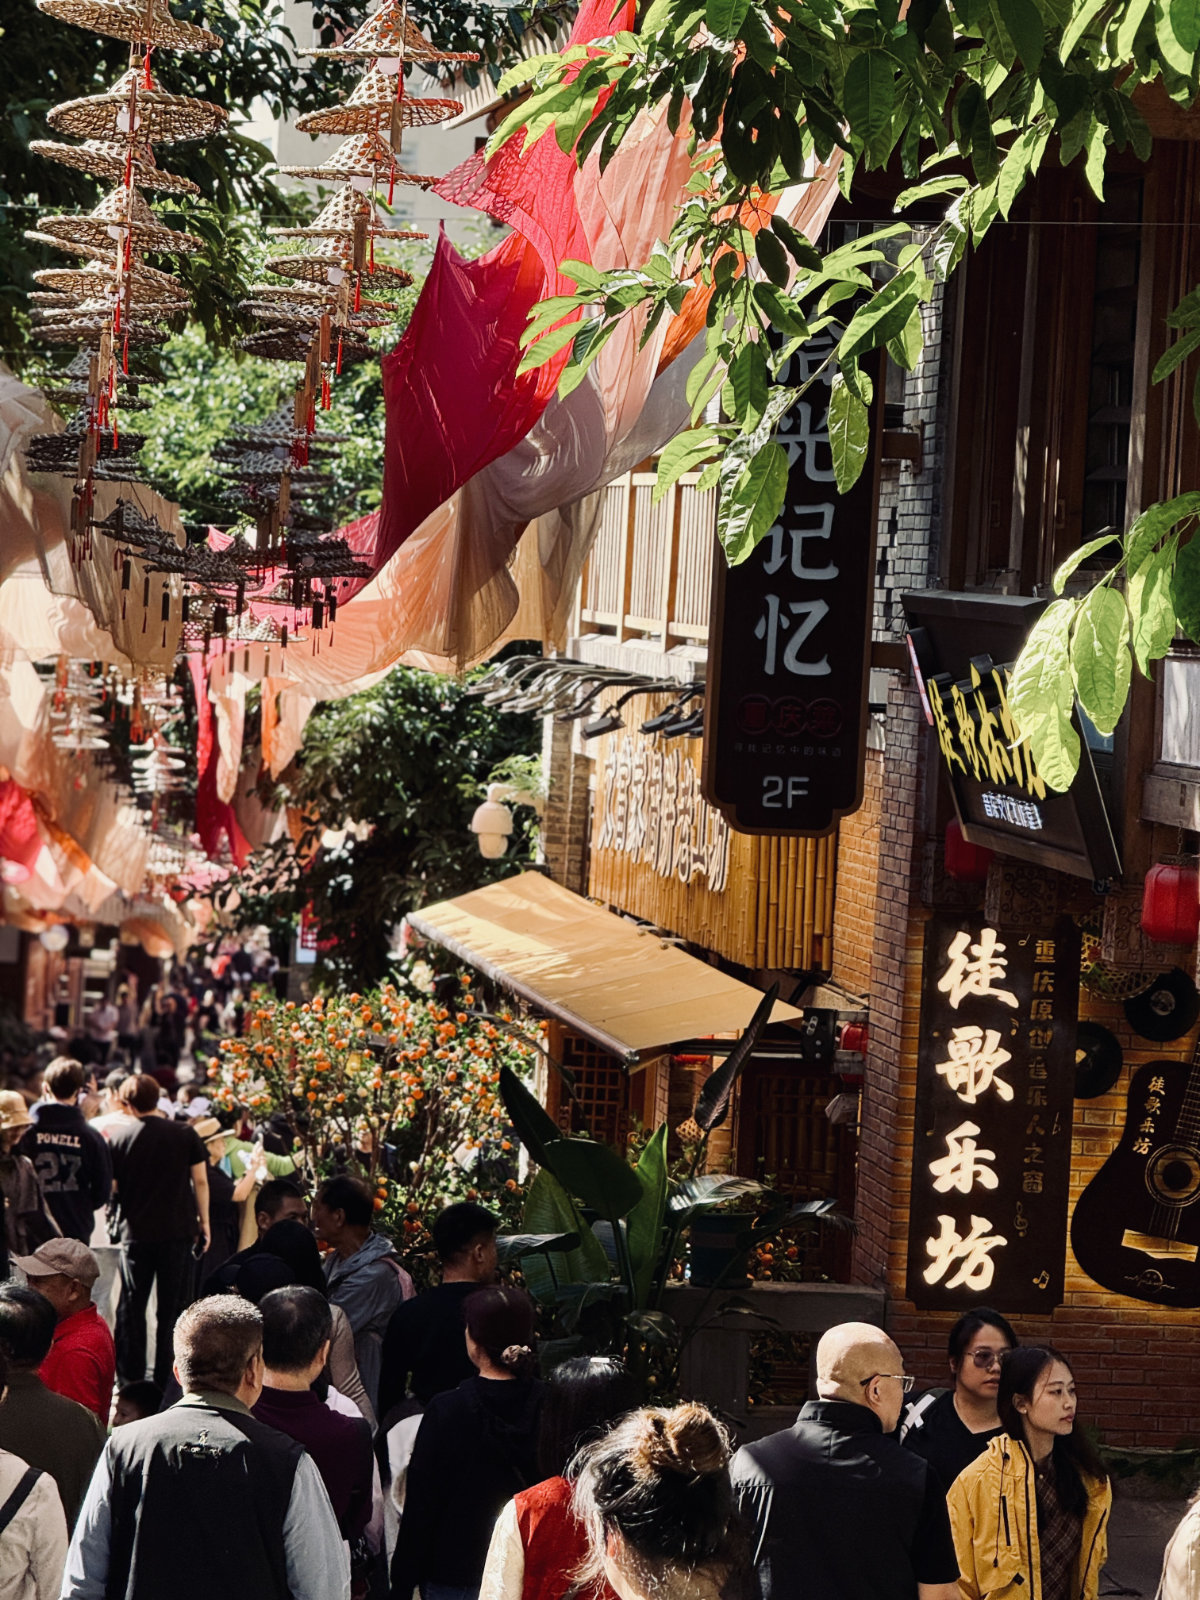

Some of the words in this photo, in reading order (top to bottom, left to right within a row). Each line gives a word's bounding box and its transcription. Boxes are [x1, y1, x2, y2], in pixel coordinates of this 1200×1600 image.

[761, 775, 810, 809] 2F
[1022, 940, 1056, 1194] 重庆原创音乐人之窗
[923, 928, 1019, 1290] 徒歌乐坊
[1133, 1076, 1166, 1155] 徒歌乐坊
[37, 1132, 81, 1148] POWELL
[35, 1152, 82, 1191] 27
